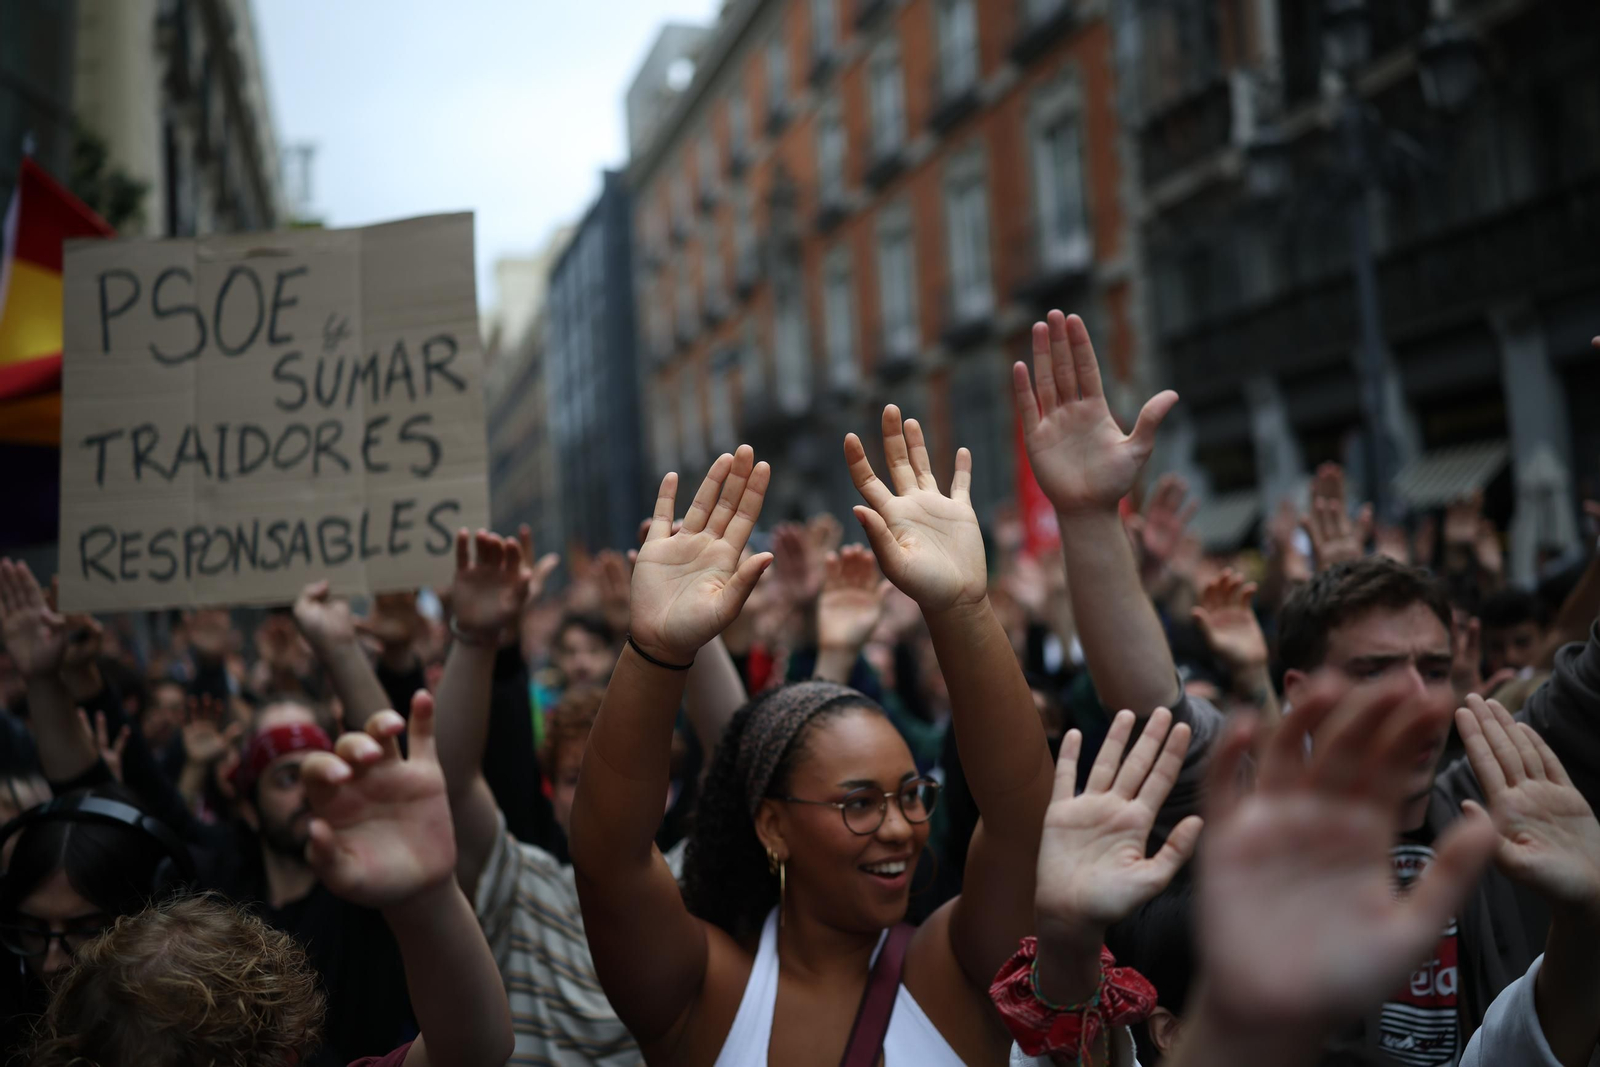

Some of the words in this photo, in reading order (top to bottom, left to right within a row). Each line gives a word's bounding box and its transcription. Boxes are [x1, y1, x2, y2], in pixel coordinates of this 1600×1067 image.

[96, 265, 308, 366] PSOE
[272, 334, 467, 411] SUMAR
[80, 414, 442, 486] TRAIDORES
[79, 500, 460, 583] RESPONSABLES
